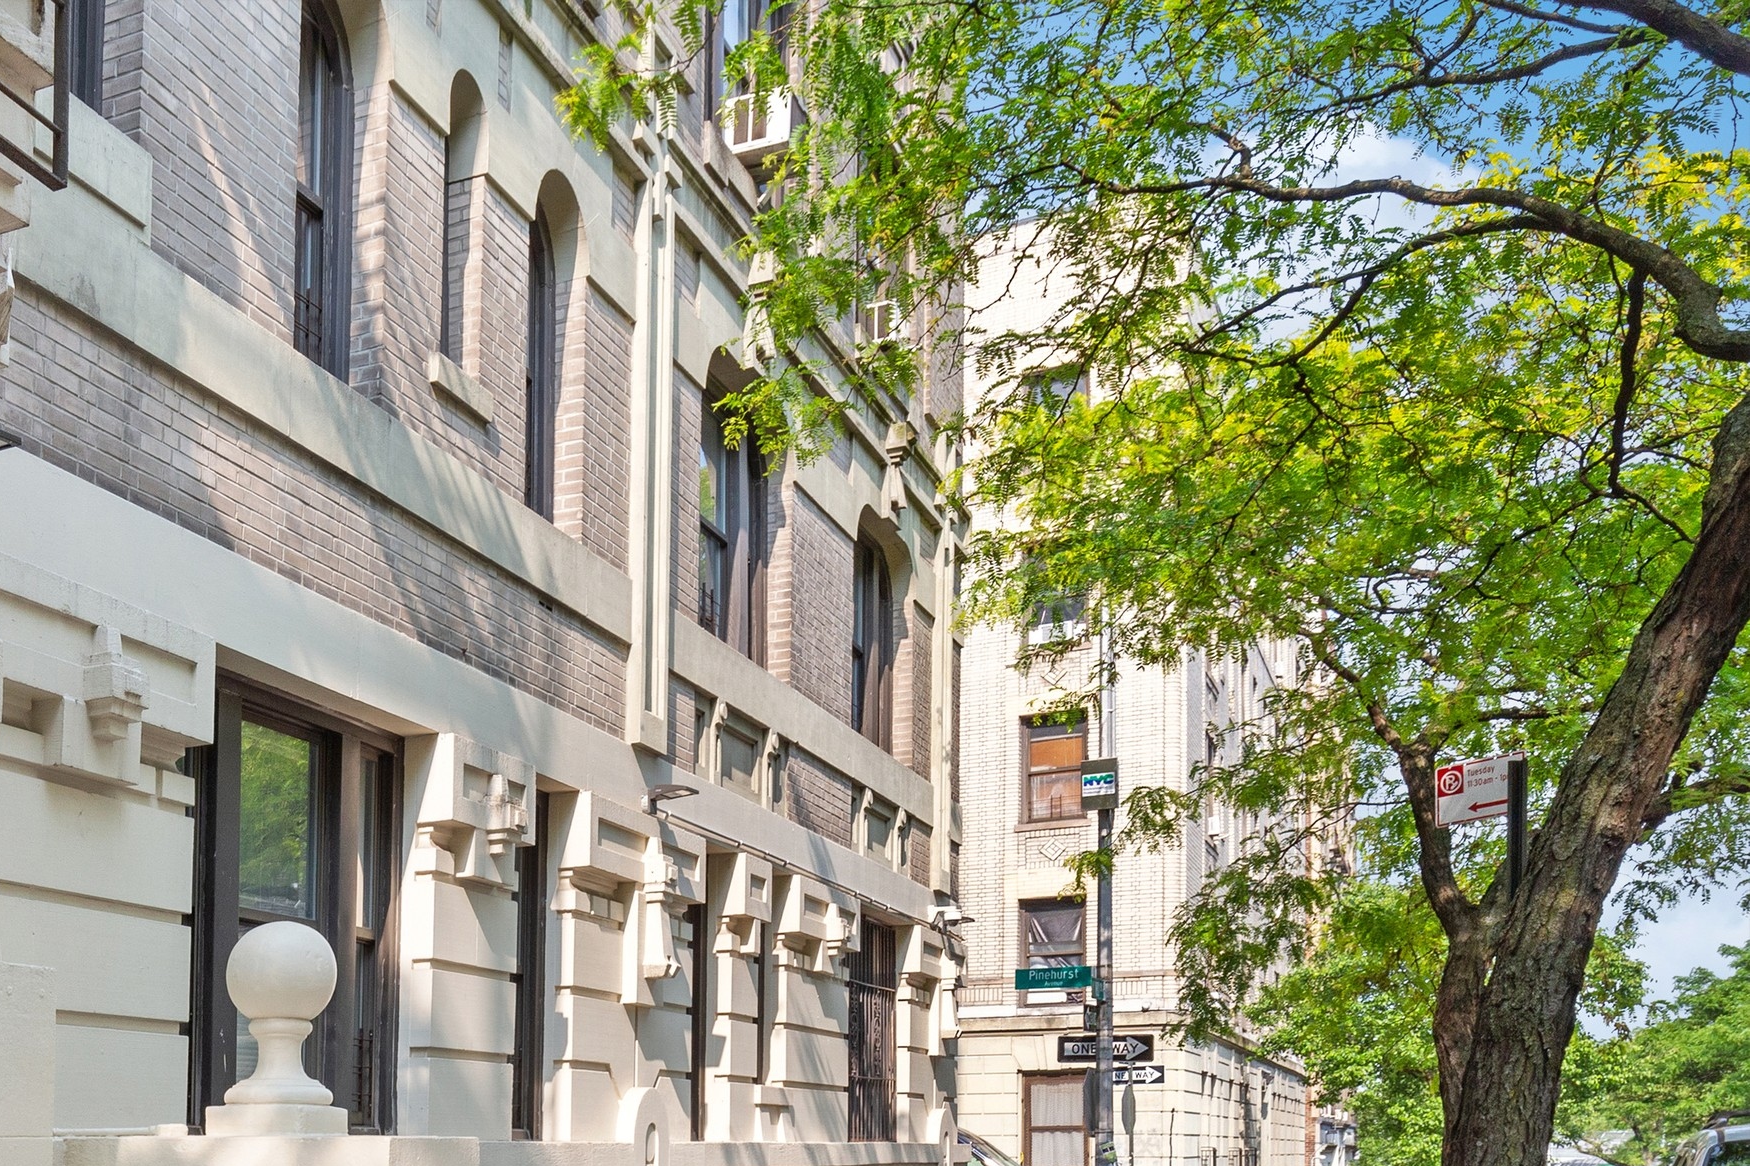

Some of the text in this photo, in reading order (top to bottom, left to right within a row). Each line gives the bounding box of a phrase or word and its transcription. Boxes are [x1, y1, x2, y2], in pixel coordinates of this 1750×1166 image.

[1467, 766, 1496, 776] Tuesday
[1083, 773, 1114, 787] NYC
[1499, 773, 1508, 782] 1p
[1028, 968, 1079, 981] Pinehurst
[1071, 1042, 1140, 1054] ONE WAY
[1114, 1071, 1155, 1080] NE WAY
